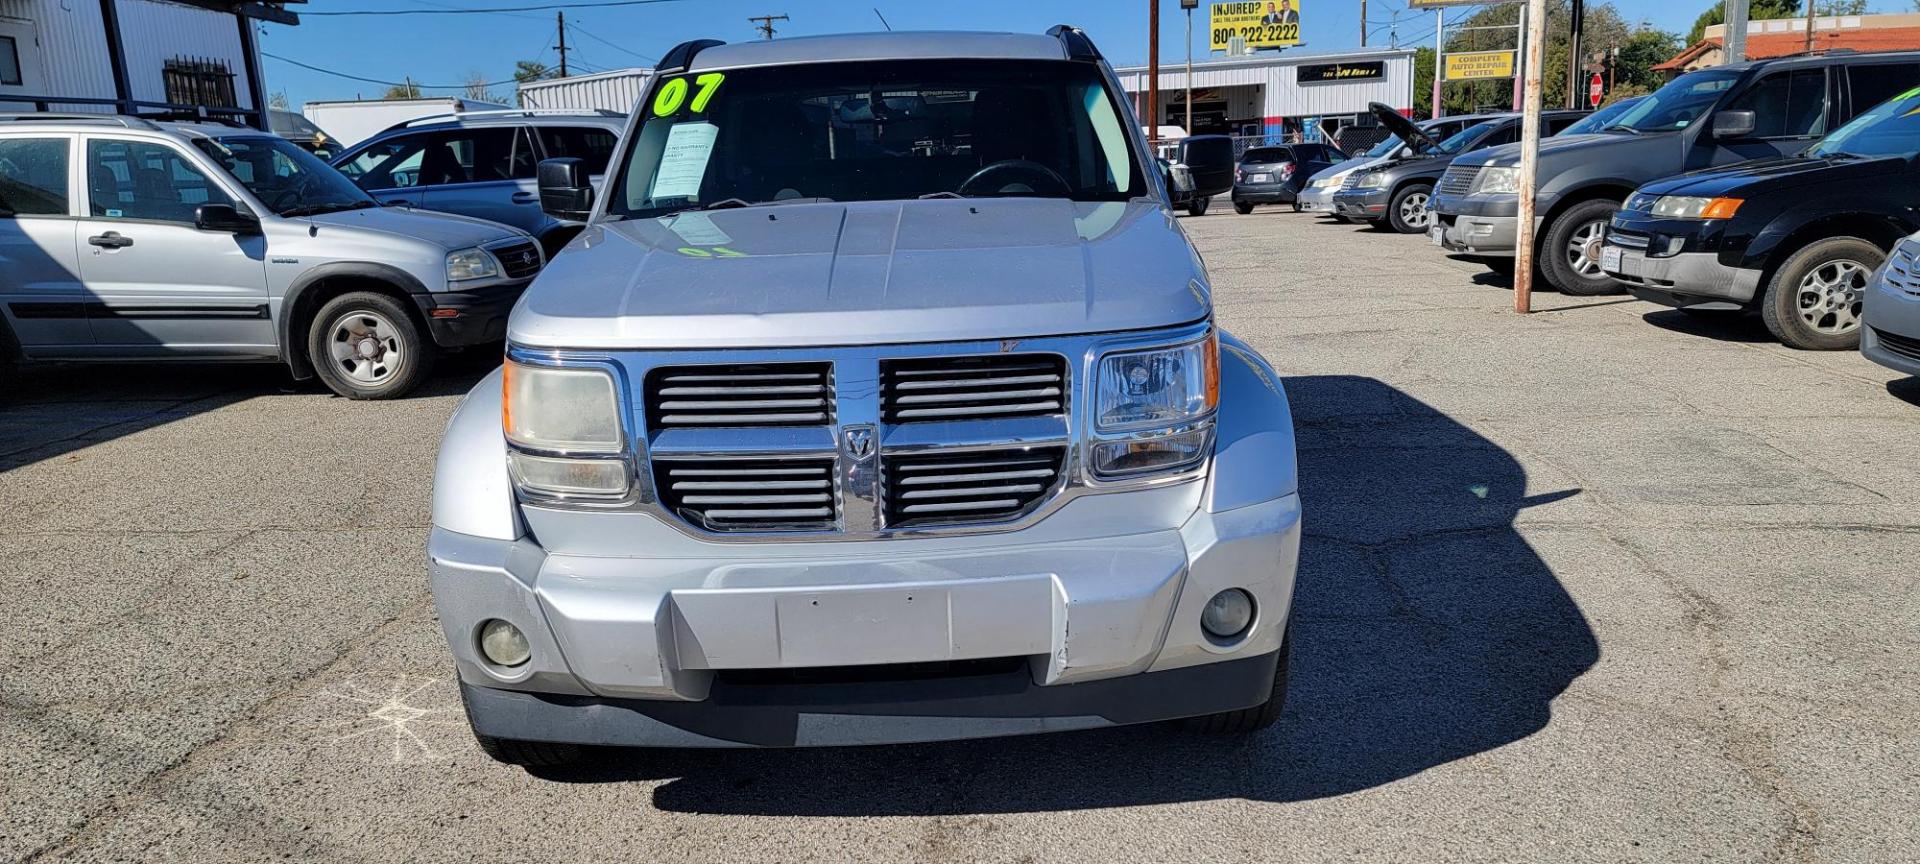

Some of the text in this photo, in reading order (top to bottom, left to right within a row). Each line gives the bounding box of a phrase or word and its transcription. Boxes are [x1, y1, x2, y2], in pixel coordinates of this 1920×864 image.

[1213, 2, 1261, 16] INJURED?
[1213, 24, 1298, 44] 800222-2222
[1458, 55, 1502, 63] COMPLETE
[653, 72, 725, 117] 07
